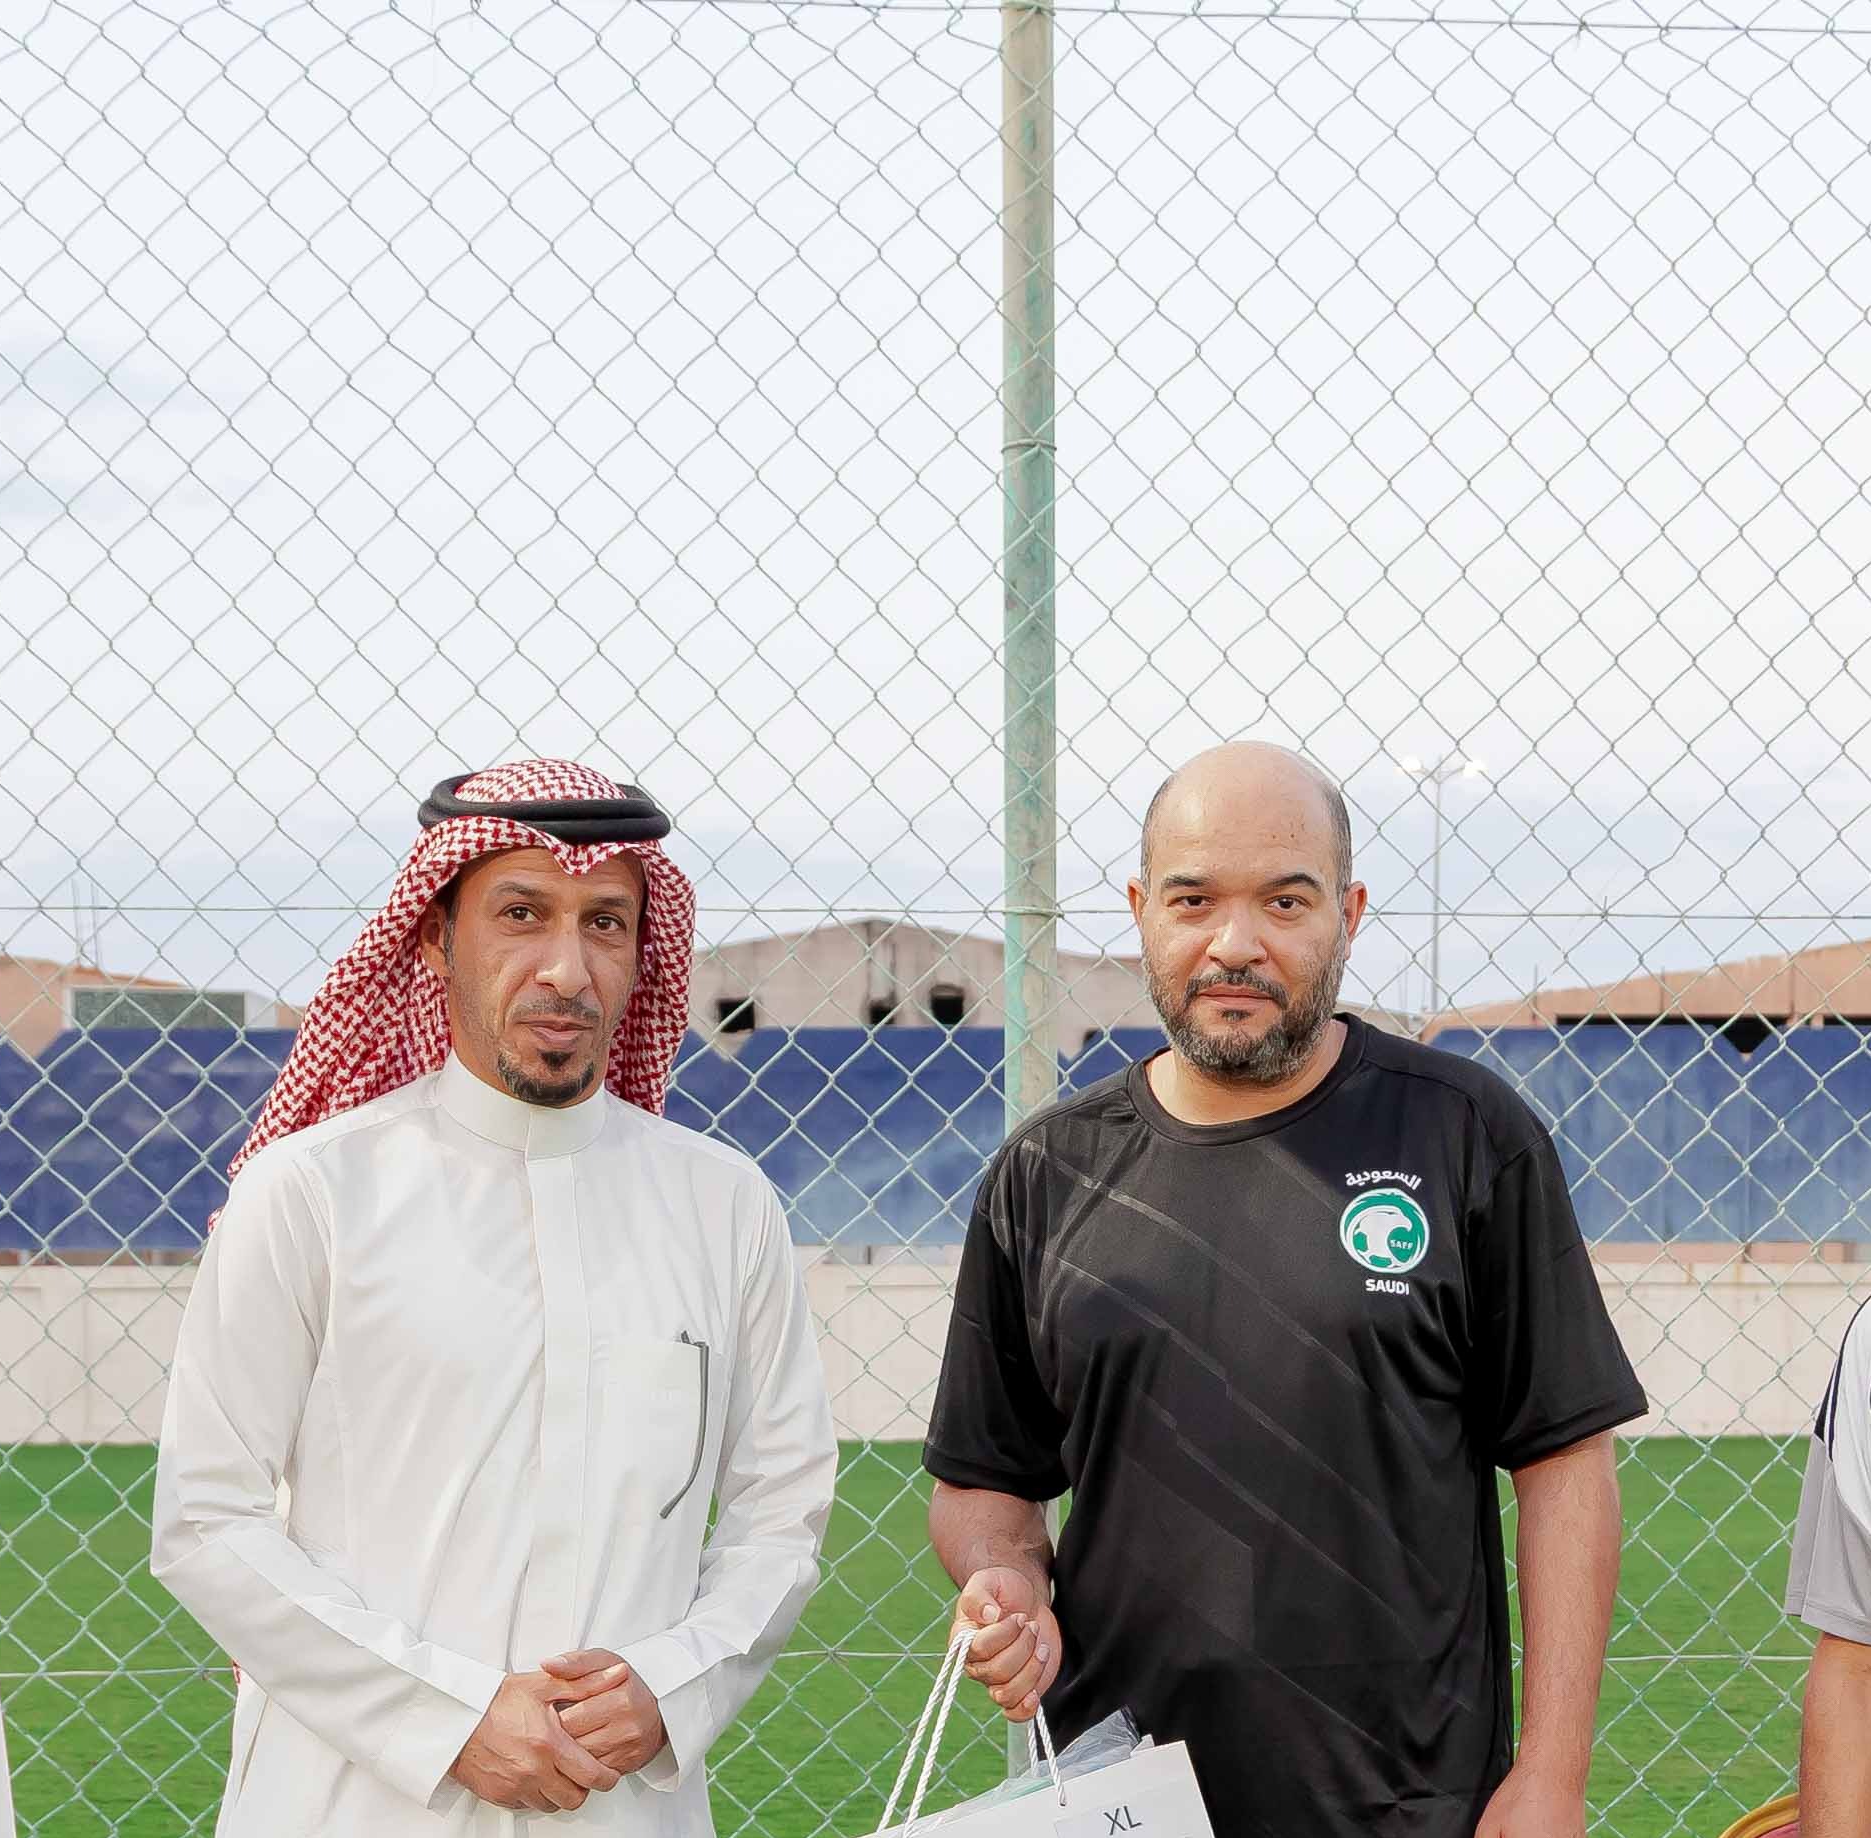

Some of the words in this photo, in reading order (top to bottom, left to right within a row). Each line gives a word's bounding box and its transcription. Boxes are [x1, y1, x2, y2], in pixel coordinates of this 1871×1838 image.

[1345, 1170, 1422, 1190] السعودية
[1365, 1279, 1410, 1295] SAUDI
[1103, 1805, 1142, 1836] XL
